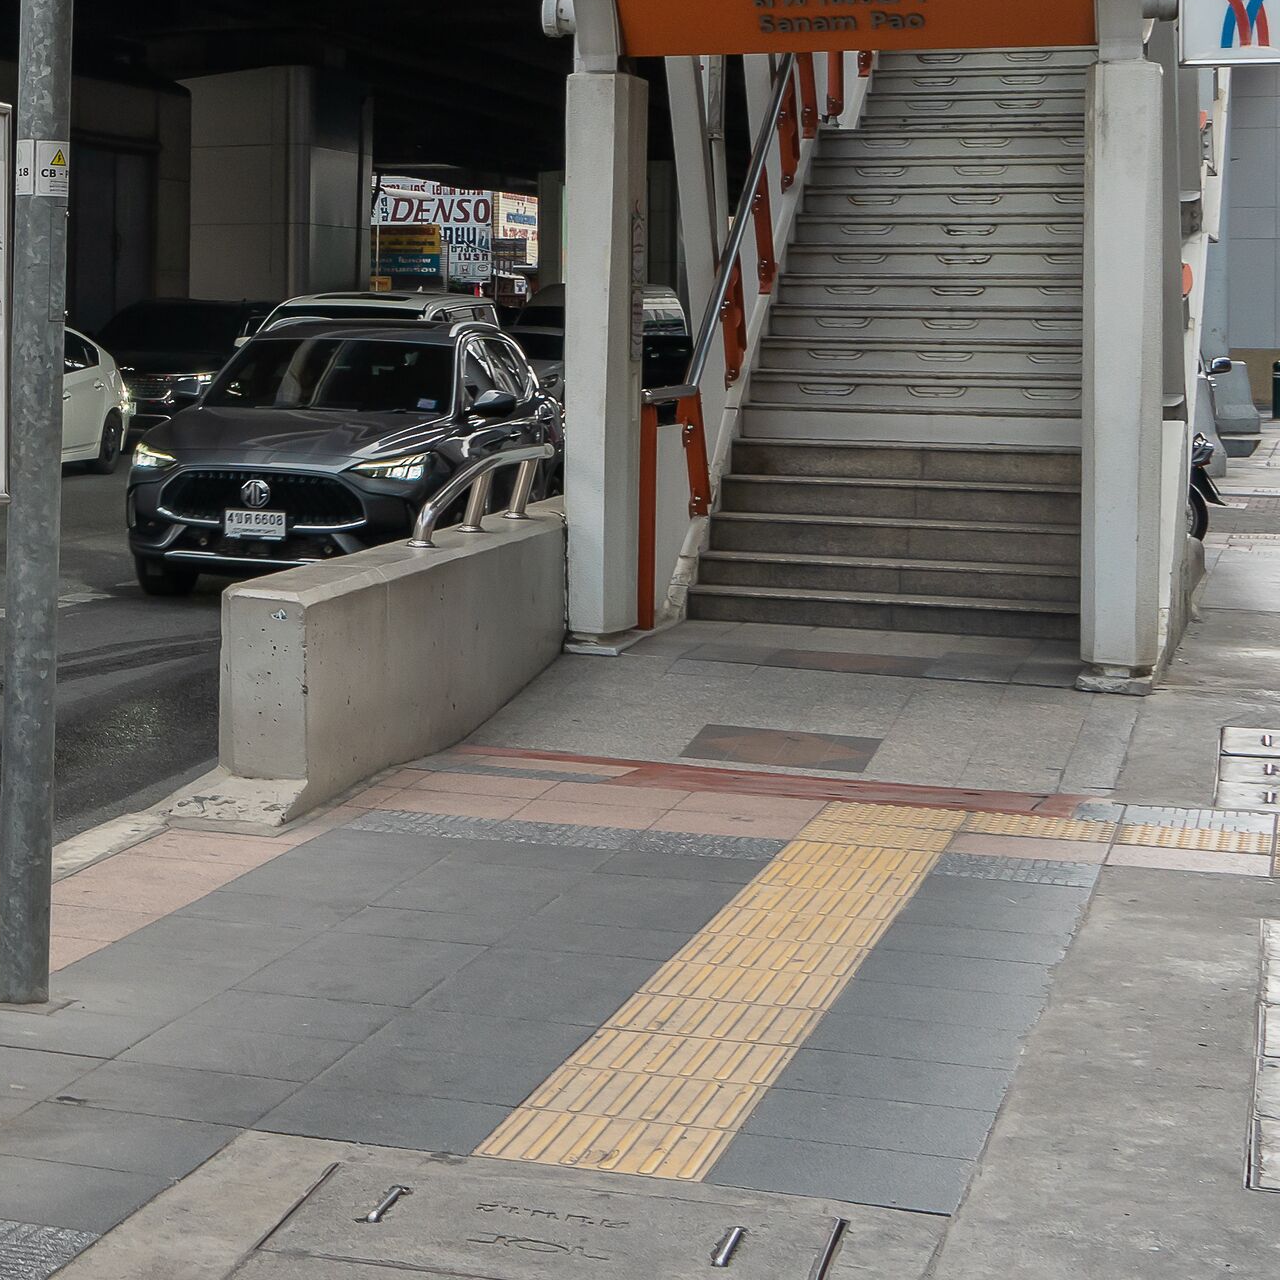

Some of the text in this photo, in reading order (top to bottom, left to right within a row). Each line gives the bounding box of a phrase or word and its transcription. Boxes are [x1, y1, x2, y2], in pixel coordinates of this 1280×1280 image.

[759, 9, 926, 34] Sanam Pao
[40, 168, 57, 178] CB
[390, 198, 490, 223] DENSO
